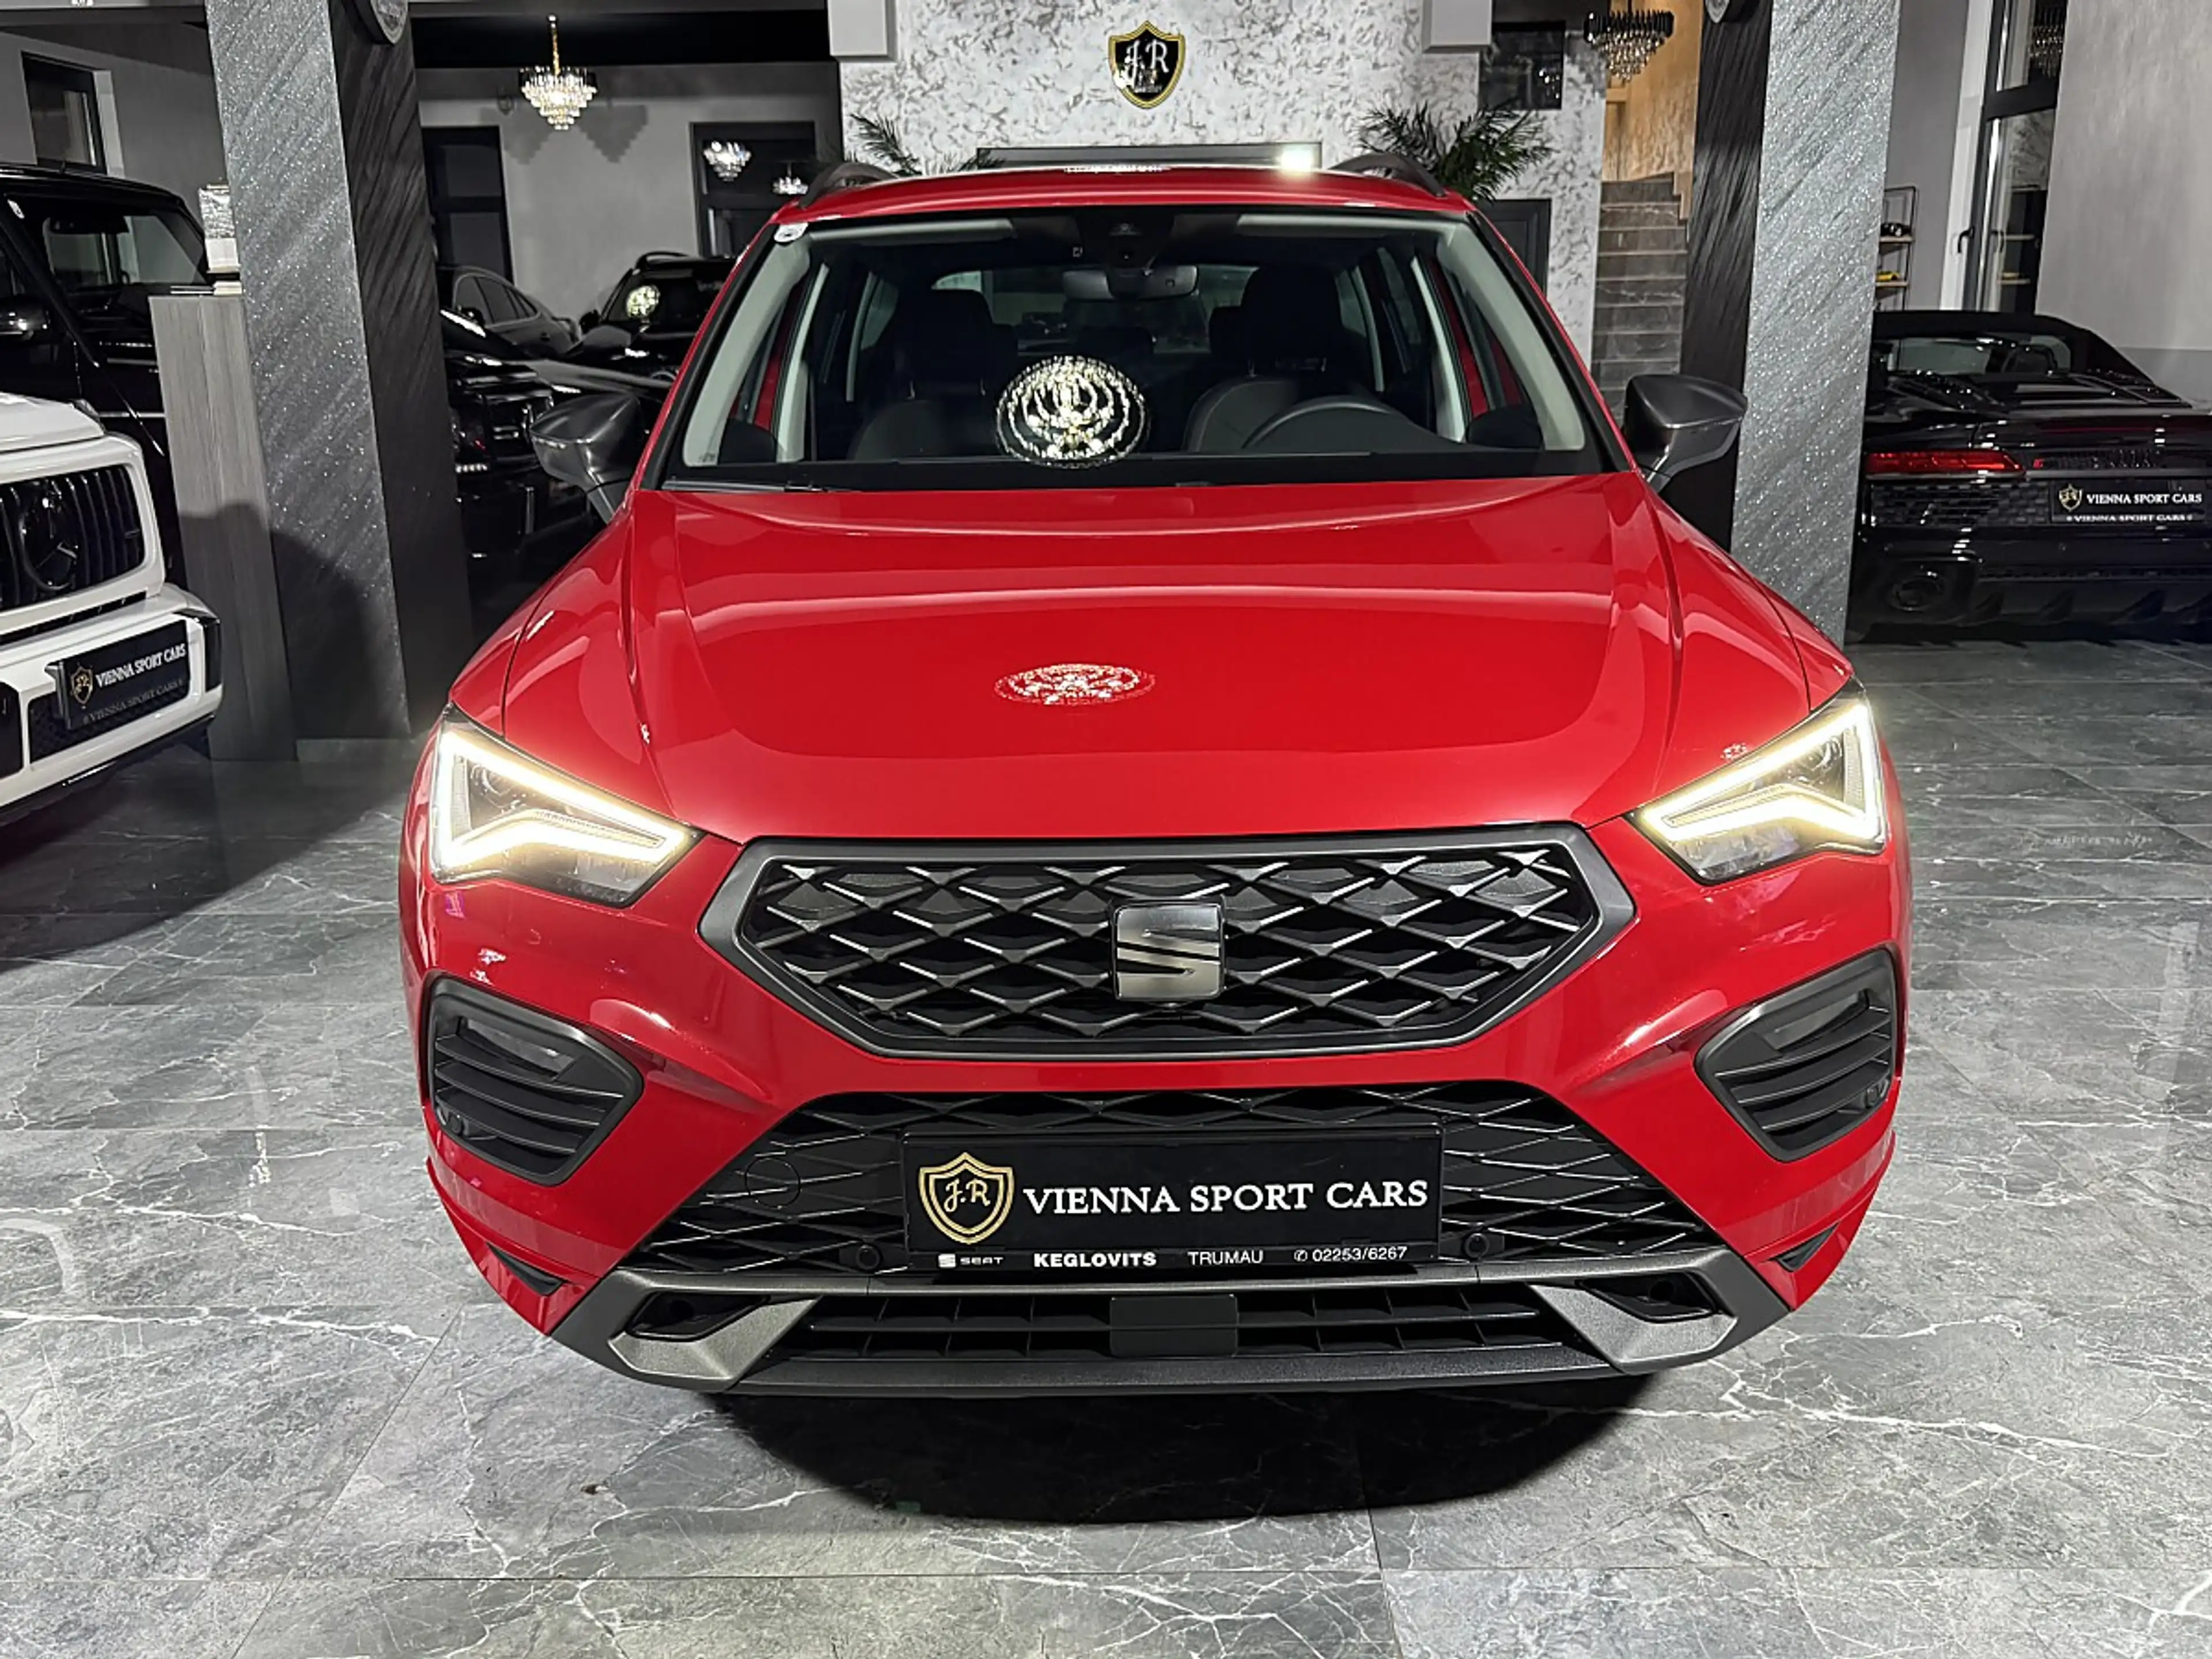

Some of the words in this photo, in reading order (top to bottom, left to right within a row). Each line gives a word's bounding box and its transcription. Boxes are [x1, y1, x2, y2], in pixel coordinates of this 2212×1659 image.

[2086, 494, 2131, 504] VIENNA
[2134, 494, 2169, 504] SPORT
[2172, 493, 2202, 503] CARS
[95, 664, 135, 688] VIENNA
[134, 652, 163, 675] SPORT
[164, 643, 187, 662] CARS
[1022, 1185, 1180, 1214] VIENNA
[1190, 1183, 1313, 1212] SPORT
[1325, 1180, 1428, 1209] CARS
[960, 1256, 1003, 1266] SEAT
[1034, 1251, 1157, 1267] KEGLOVITS
[1187, 1249, 1264, 1266] TRUMAU
[1312, 1245, 1408, 1263] 02253/6267
